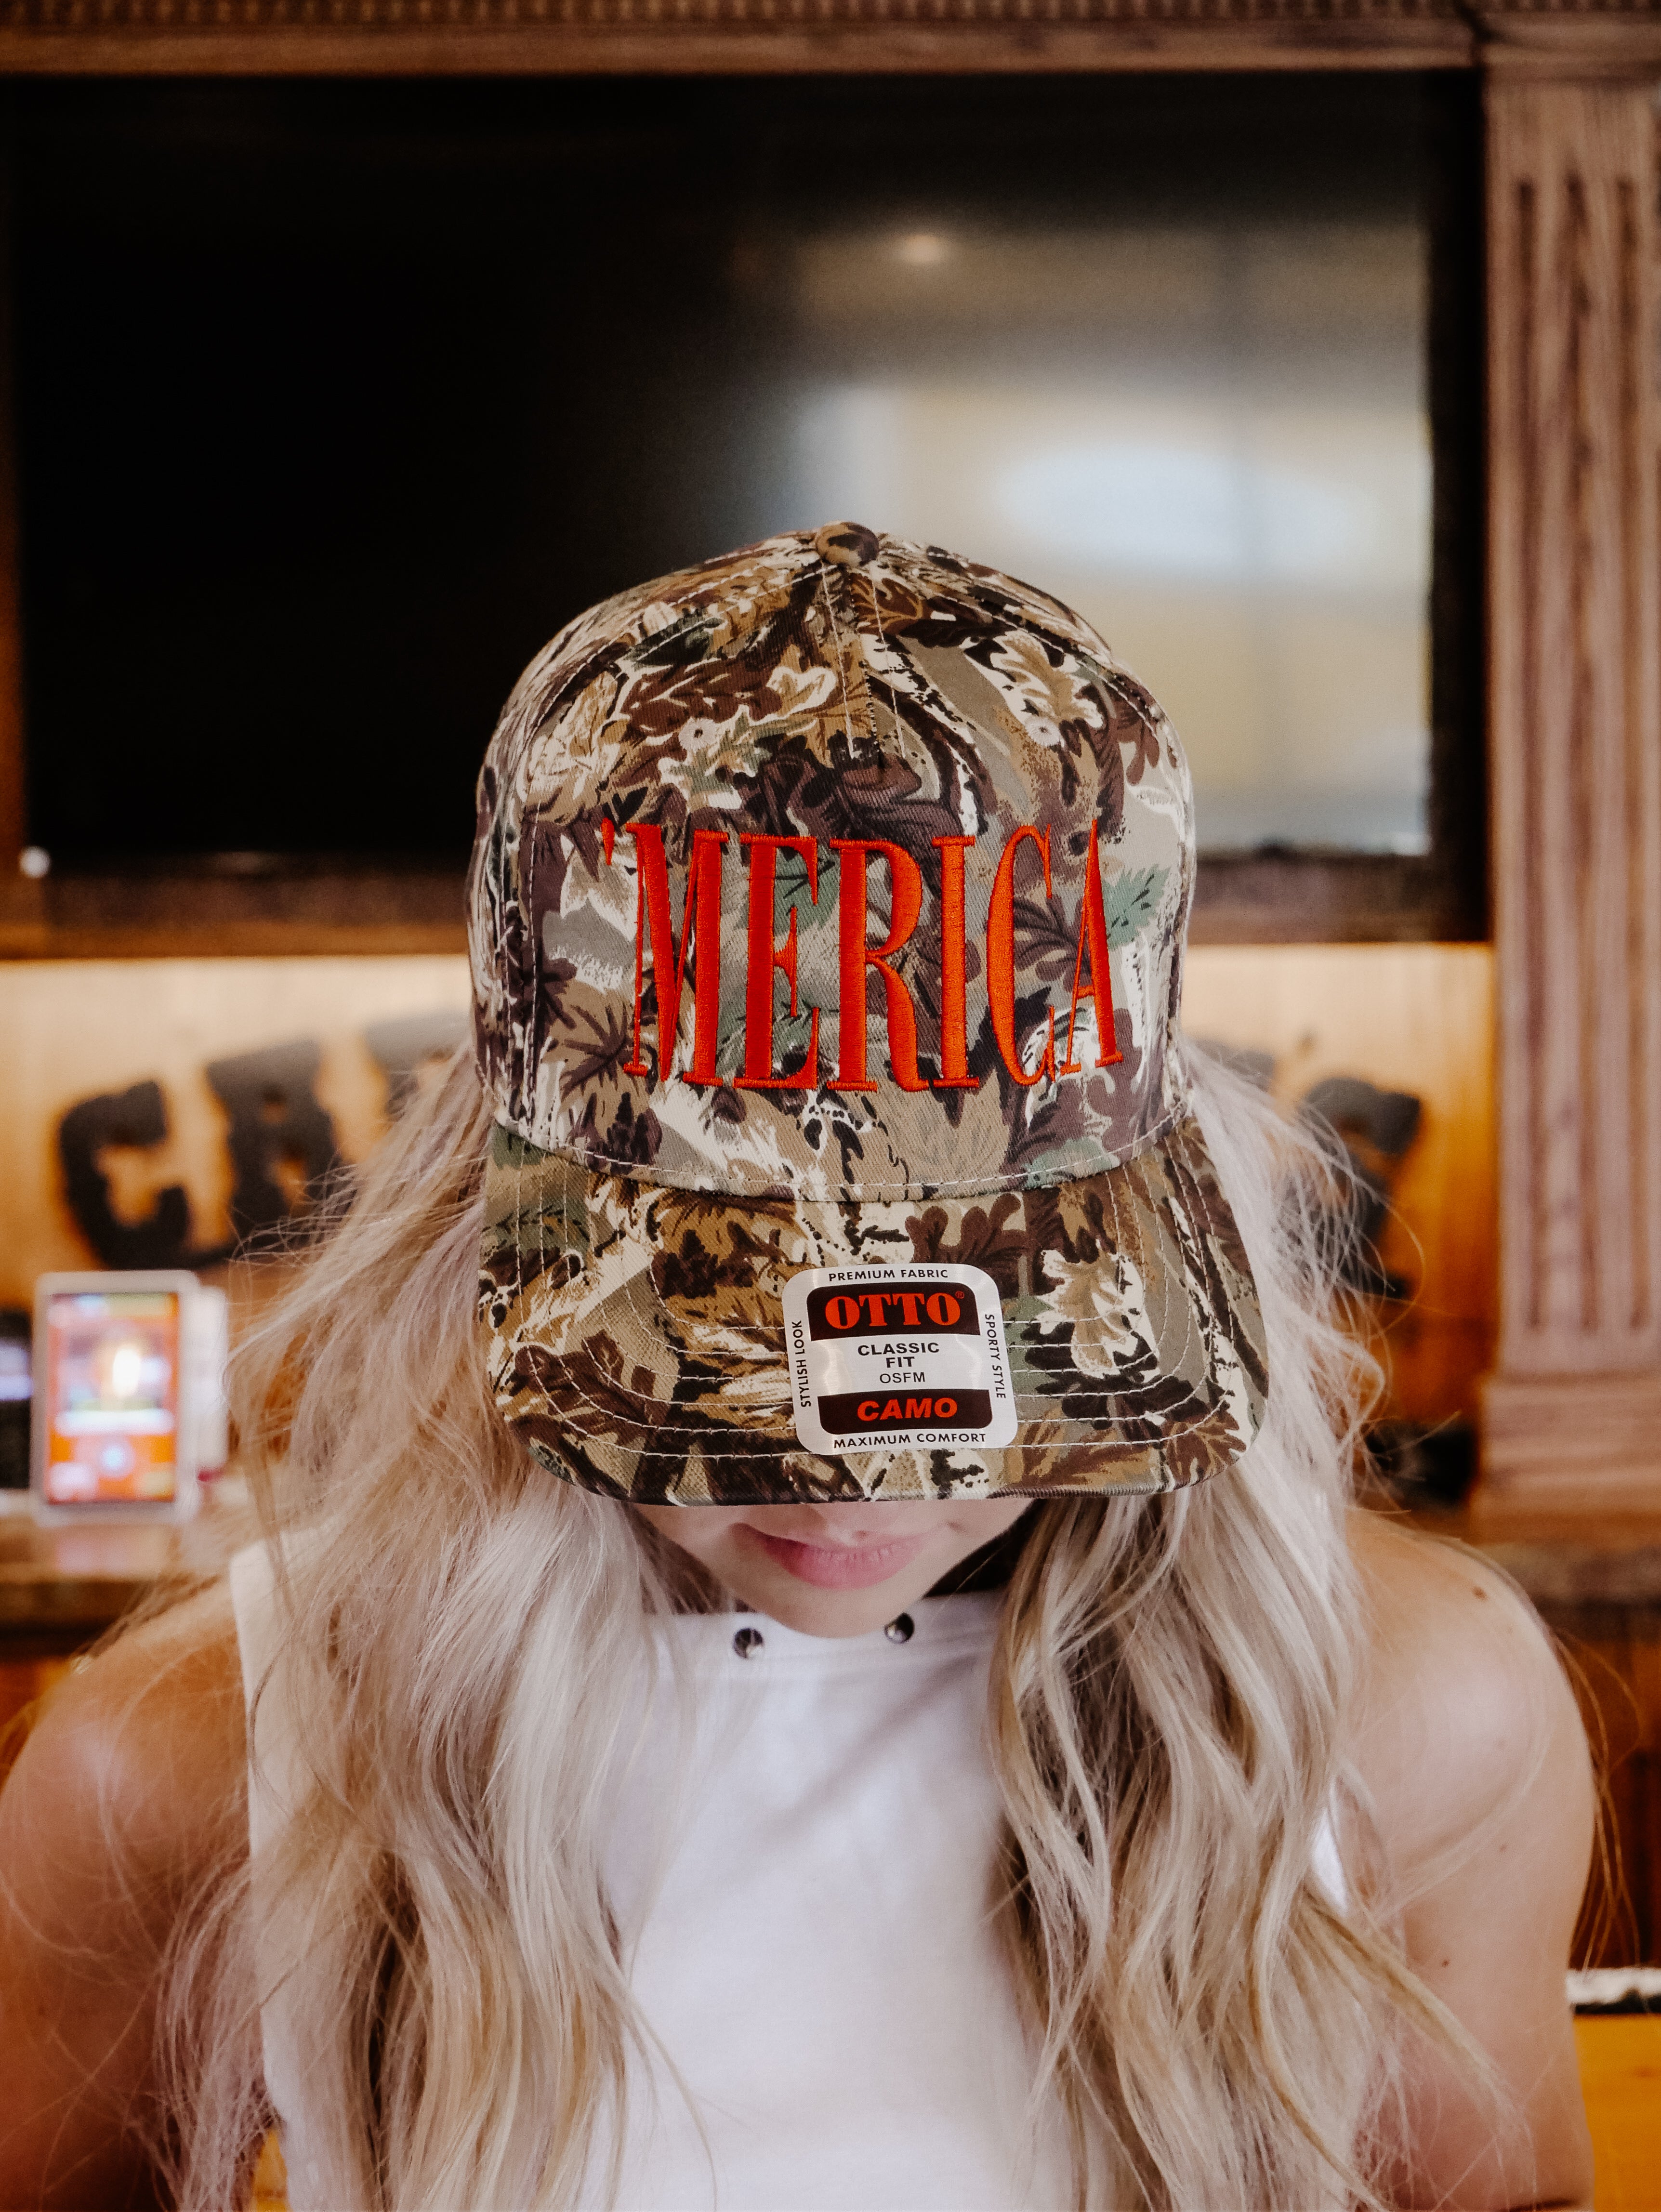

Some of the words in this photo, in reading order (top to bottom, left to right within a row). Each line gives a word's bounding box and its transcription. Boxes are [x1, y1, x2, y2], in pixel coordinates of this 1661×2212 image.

[601, 817, 1123, 1093] 'MERICA
[829, 1270, 895, 1281] PREMIUM
[901, 1270, 948, 1278] FABRIC
[792, 1320, 804, 1355] LOOK
[985, 1315, 1001, 1361] SPORTY
[858, 1343, 939, 1356] CLASSIC
[886, 1356, 915, 1368] FIT
[796, 1359, 811, 1407] STYLISH
[880, 1372, 925, 1383] OSFM
[992, 1365, 1006, 1398] STYLE
[857, 1398, 957, 1421] CAMO
[834, 1435, 910, 1448] MAXIMUM
[917, 1433, 986, 1443] COMFORT
